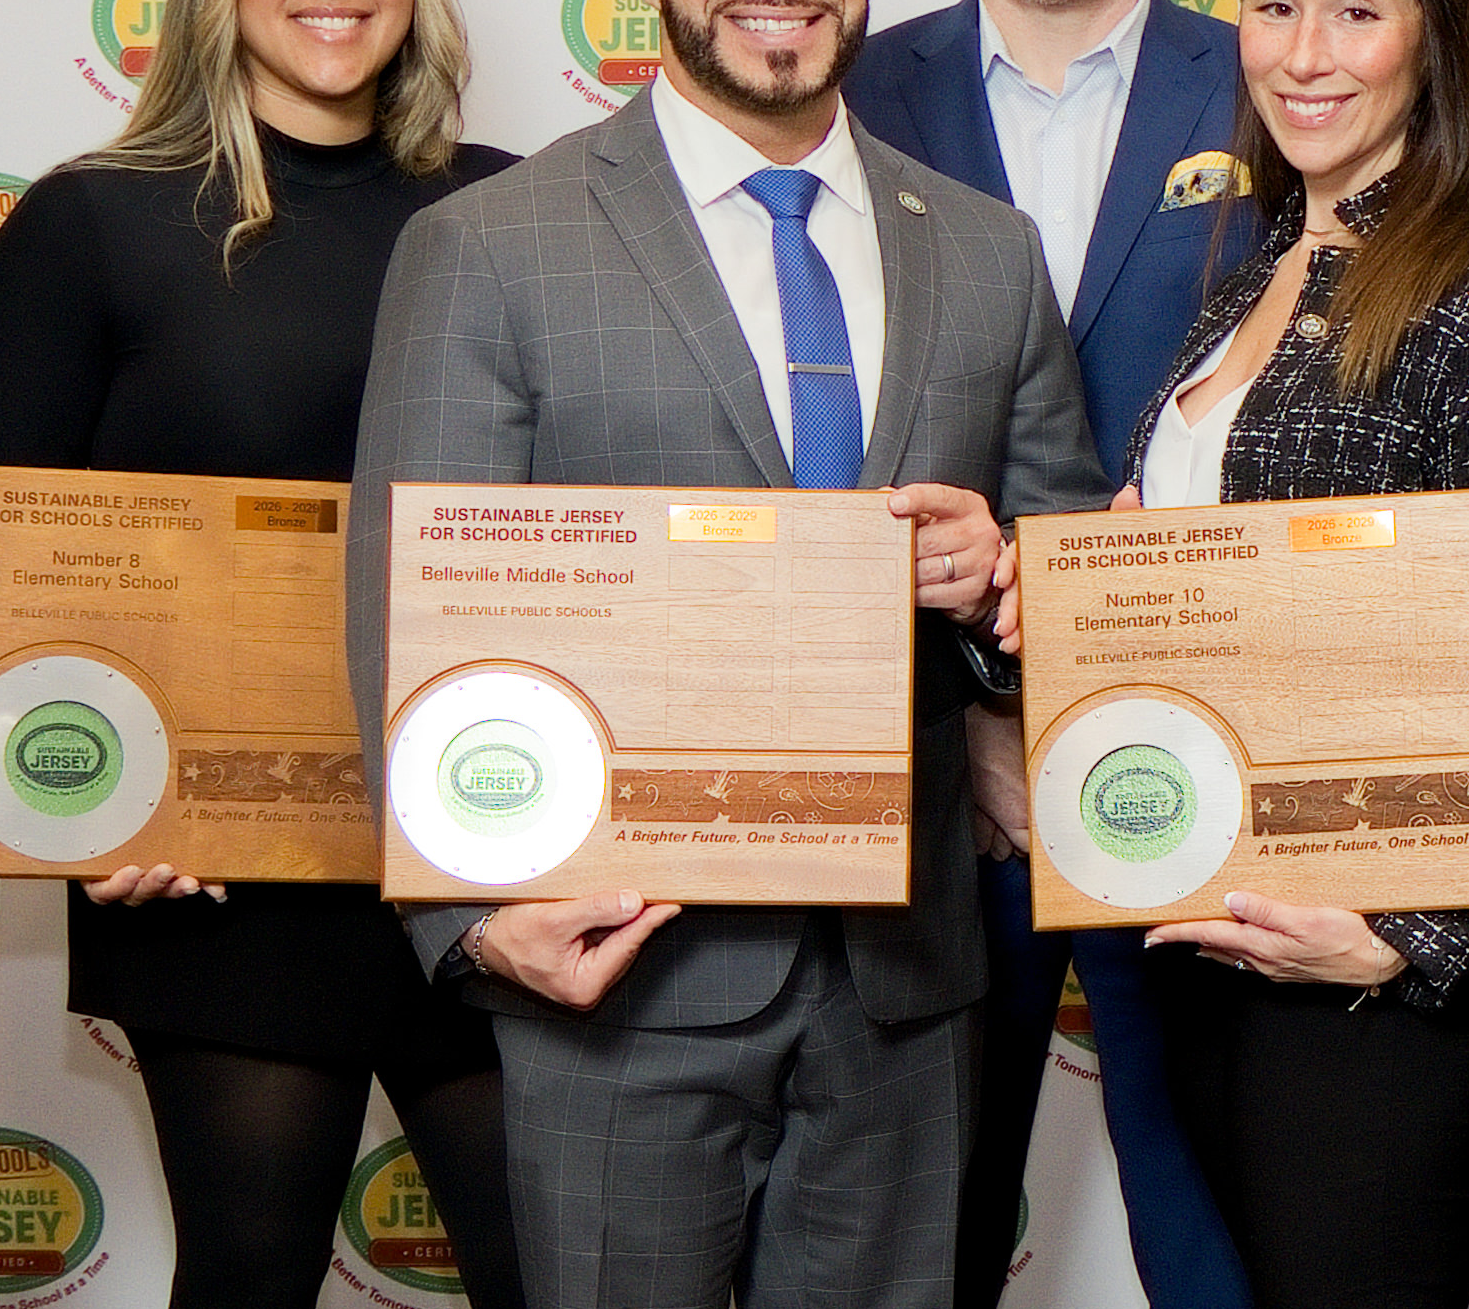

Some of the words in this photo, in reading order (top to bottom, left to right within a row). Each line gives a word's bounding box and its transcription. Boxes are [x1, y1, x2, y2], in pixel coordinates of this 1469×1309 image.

[2, 492, 122, 508] SUSTAINABLE
[128, 496, 191, 510] JERSEY
[30, 512, 112, 526] SCHOOLS
[119, 515, 203, 530] CERTIFIED
[433, 508, 554, 522] SUSTAINABLE
[560, 510, 624, 523] JERSEY
[420, 527, 453, 539] FOR
[461, 528, 543, 541] SCHOOLS
[551, 529, 636, 543] CERTIFIED
[1058, 531, 1176, 551] SUSTAINABLE
[1182, 527, 1245, 543] JERSEY
[52, 551, 121, 567] Number
[129, 553, 140, 567] 8
[1047, 557, 1080, 571] FOR
[1086, 551, 1167, 569] SCHOOLS
[1174, 545, 1259, 563] CERTIFIED
[12, 570, 111, 590] Elementary
[118, 573, 177, 589] School
[421, 566, 498, 581] Belleville
[507, 567, 565, 582] Middle
[574, 569, 633, 584] School
[1105, 591, 1174, 608] Number
[1183, 588, 1204, 603] 10
[442, 606, 506, 616] BELLEVILLE
[511, 607, 551, 616] PUBLIC
[556, 607, 611, 617] SCHOOLS
[1073, 612, 1170, 632] Elementary
[1178, 607, 1237, 625] School
[616, 830, 626, 841] A
[632, 830, 688, 844] Brighter
[691, 831, 740, 843] Future,
[747, 832, 775, 842] One
[782, 832, 827, 843] School
[832, 834, 846, 843] at
[850, 836, 858, 844] a
[866, 834, 898, 845] Time
